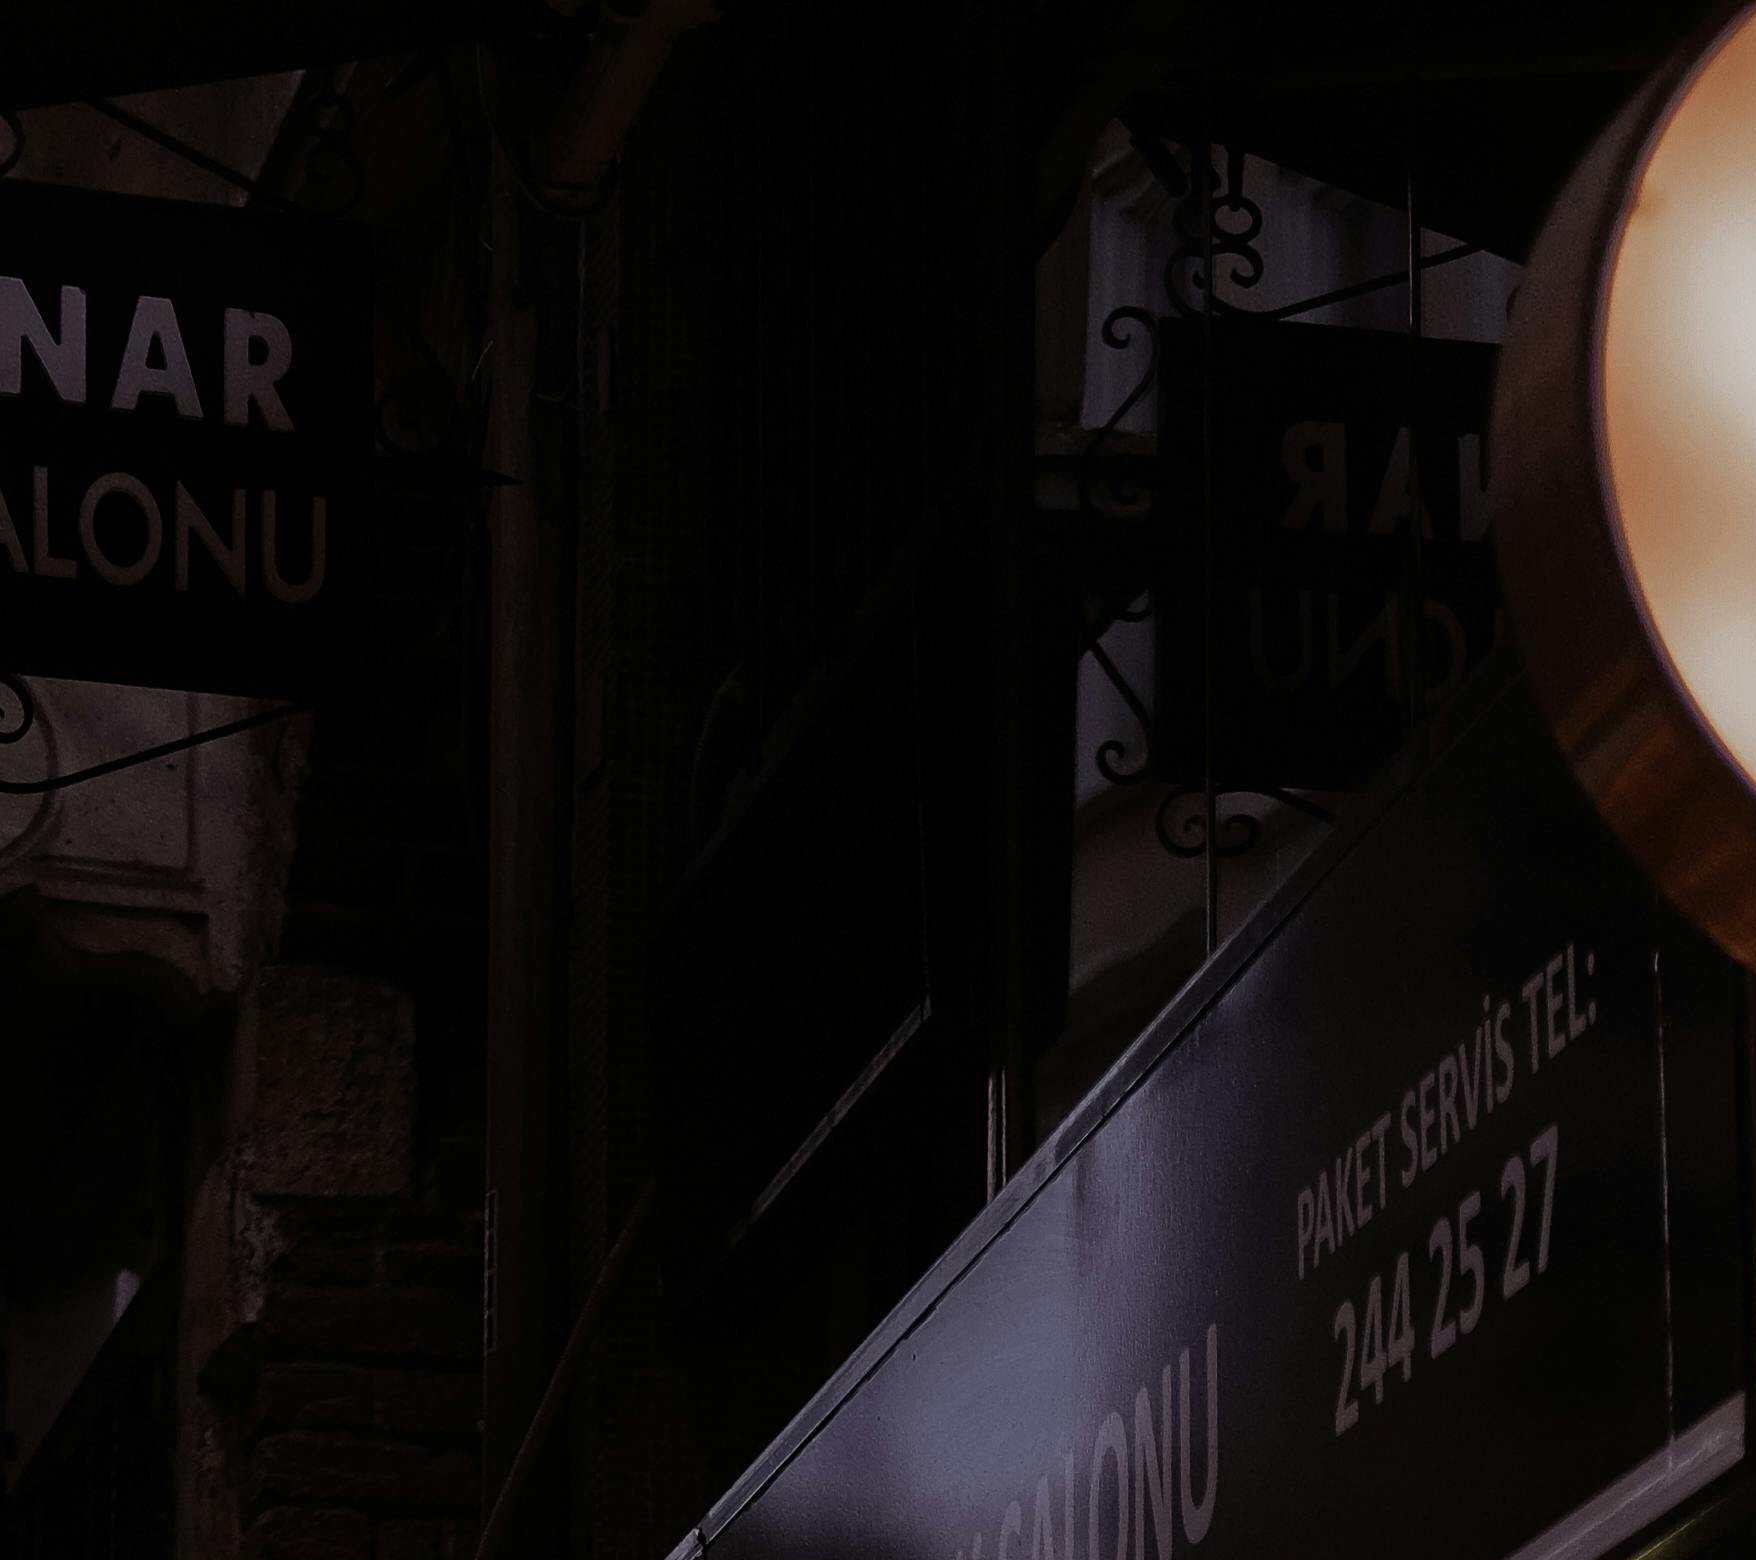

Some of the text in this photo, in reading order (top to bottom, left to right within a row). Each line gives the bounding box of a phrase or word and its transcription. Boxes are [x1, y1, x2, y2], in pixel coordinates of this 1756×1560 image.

[1297, 939, 1597, 1280] PAKET SERVİS TEL:
[1333, 1122, 1560, 1437] 244 25 27
